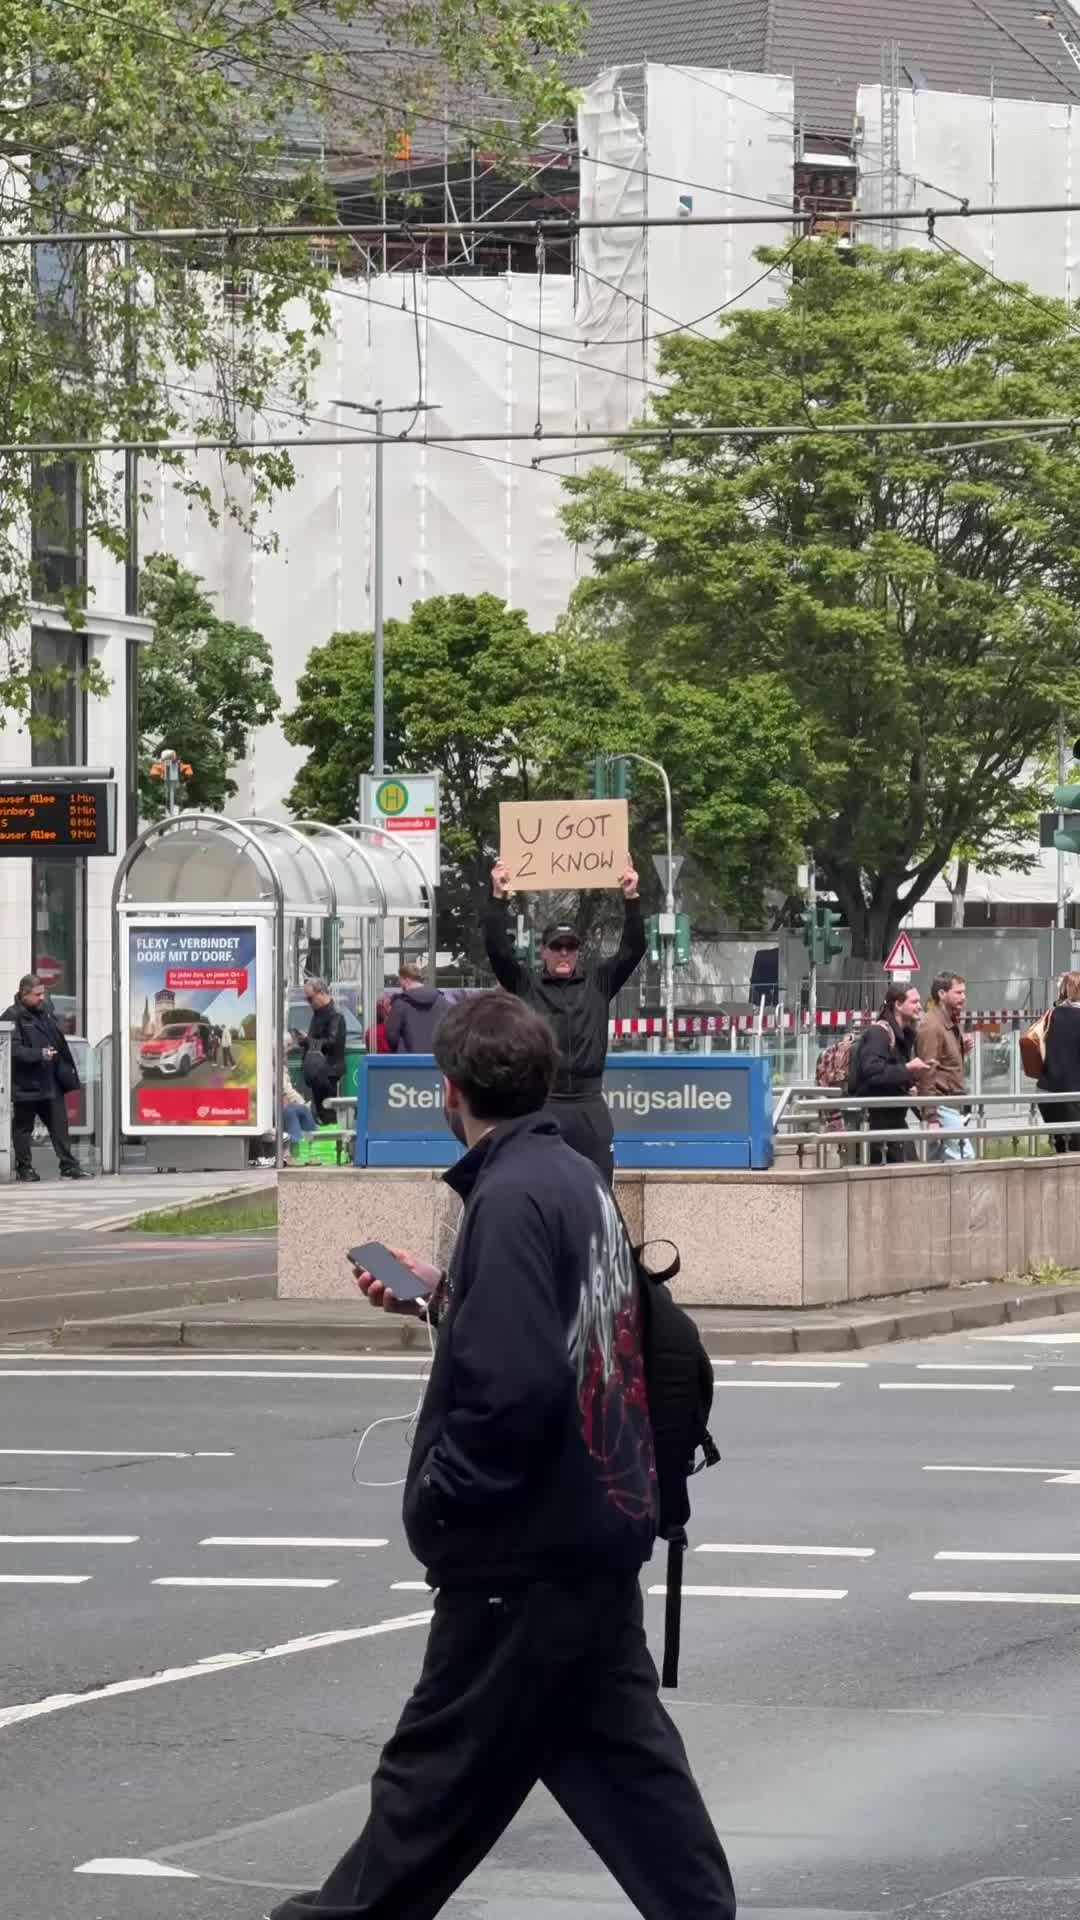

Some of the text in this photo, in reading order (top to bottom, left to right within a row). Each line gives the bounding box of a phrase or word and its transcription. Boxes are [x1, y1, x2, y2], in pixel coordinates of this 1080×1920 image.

[30, 794, 56, 803] Allee
[78, 806, 96, 815] Min
[516, 813, 612, 844] U GOT
[31, 831, 56, 839] Allee
[516, 850, 614, 877] 2 KNOW
[136, 938, 169, 949] FLEXY
[180, 937, 240, 949] VERBINDET
[136, 951, 235, 962] DORF MIT D'DORF.
[387, 1083, 444, 1108] Stei
